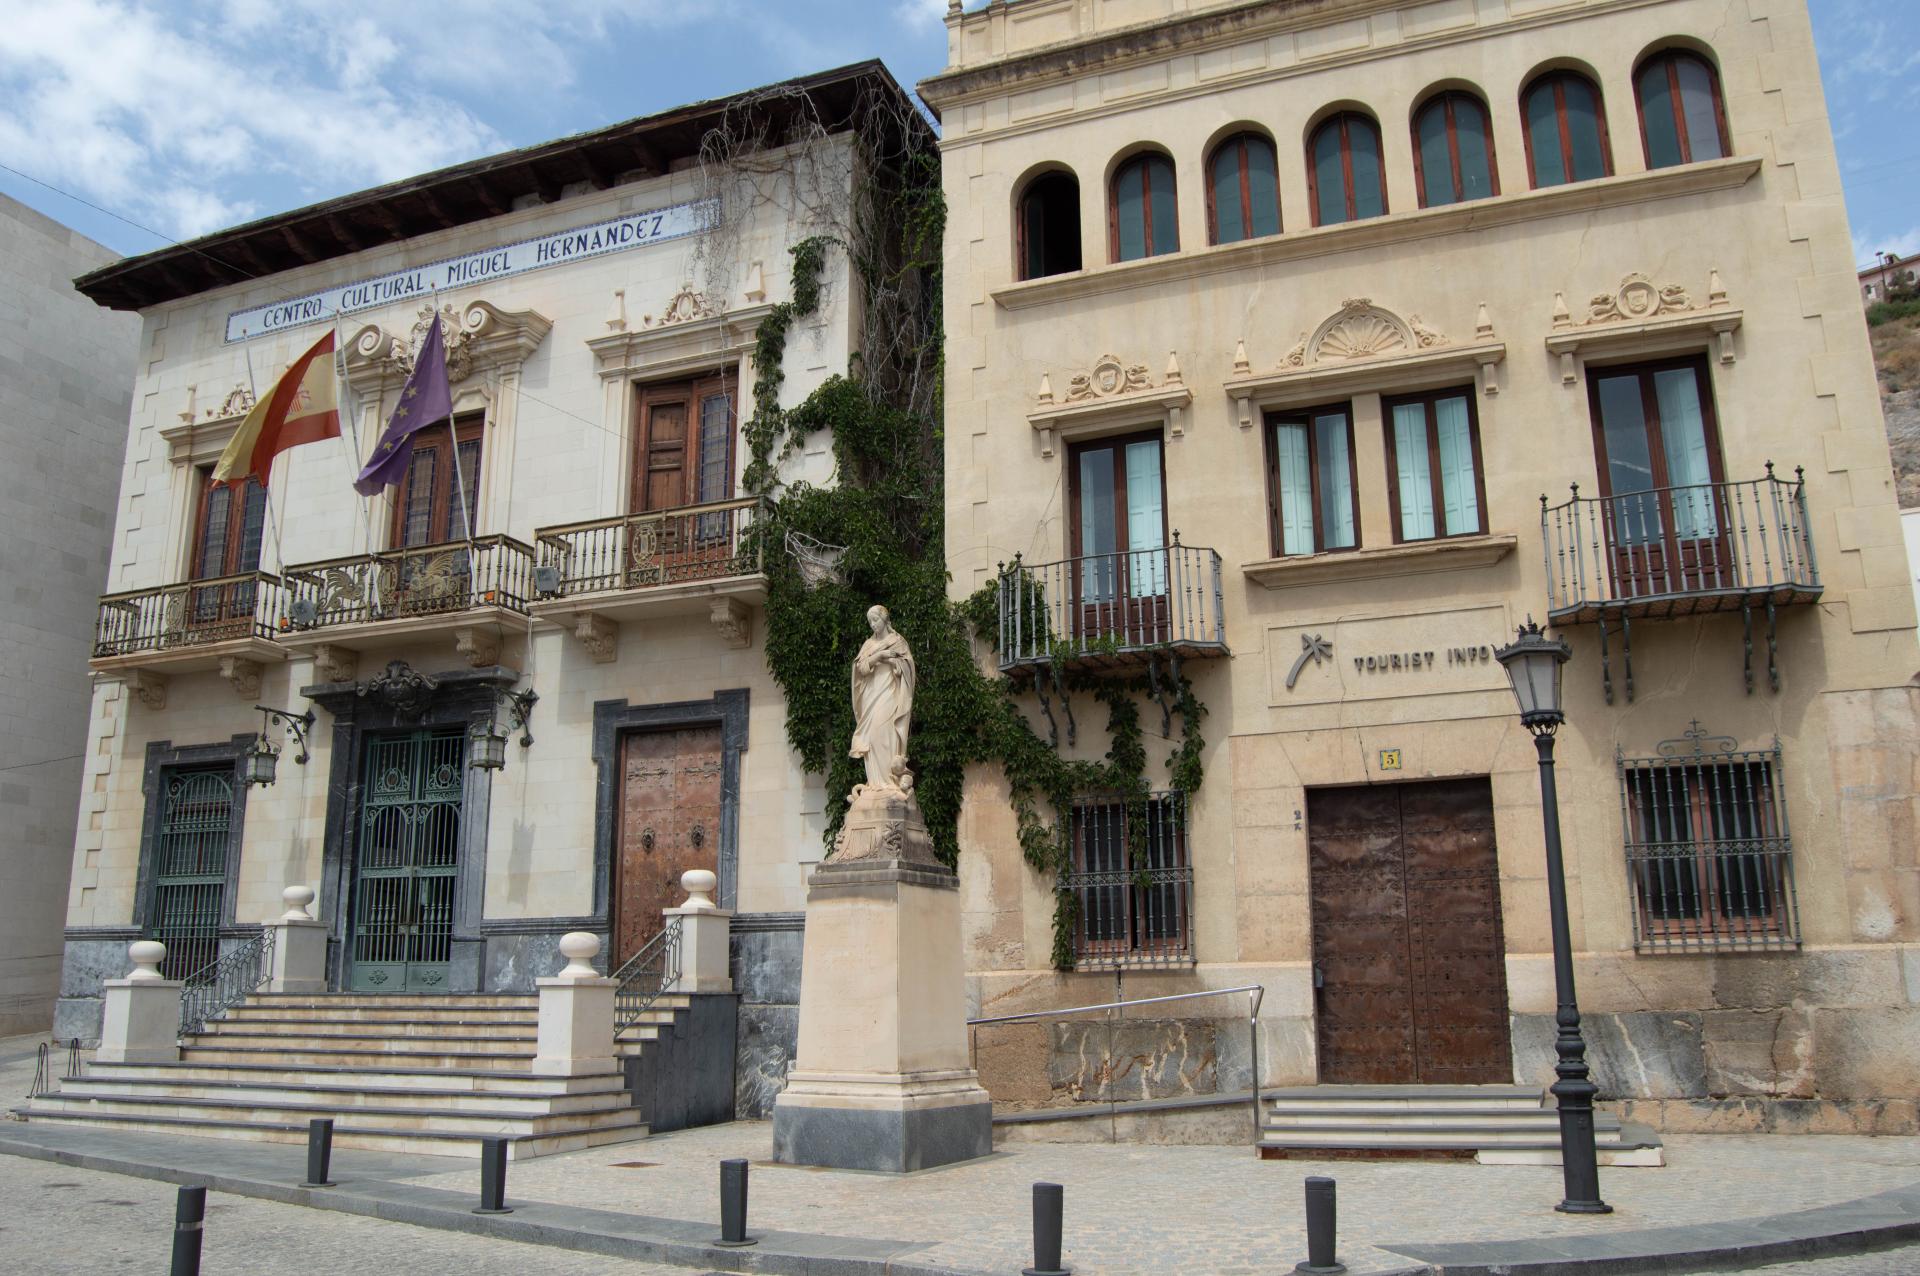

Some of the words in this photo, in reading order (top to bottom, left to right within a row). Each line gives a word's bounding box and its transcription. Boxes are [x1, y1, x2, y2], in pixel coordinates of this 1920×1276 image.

[263, 298, 322, 328] CENTRO
[341, 272, 424, 309] CULTURAL
[447, 252, 511, 284] MIGUEL
[537, 215, 664, 262] HERNANDEZ
[1354, 651, 1435, 672] TOURIST
[1448, 645, 1490, 664] INFO
[1386, 754, 1395, 766] 5
